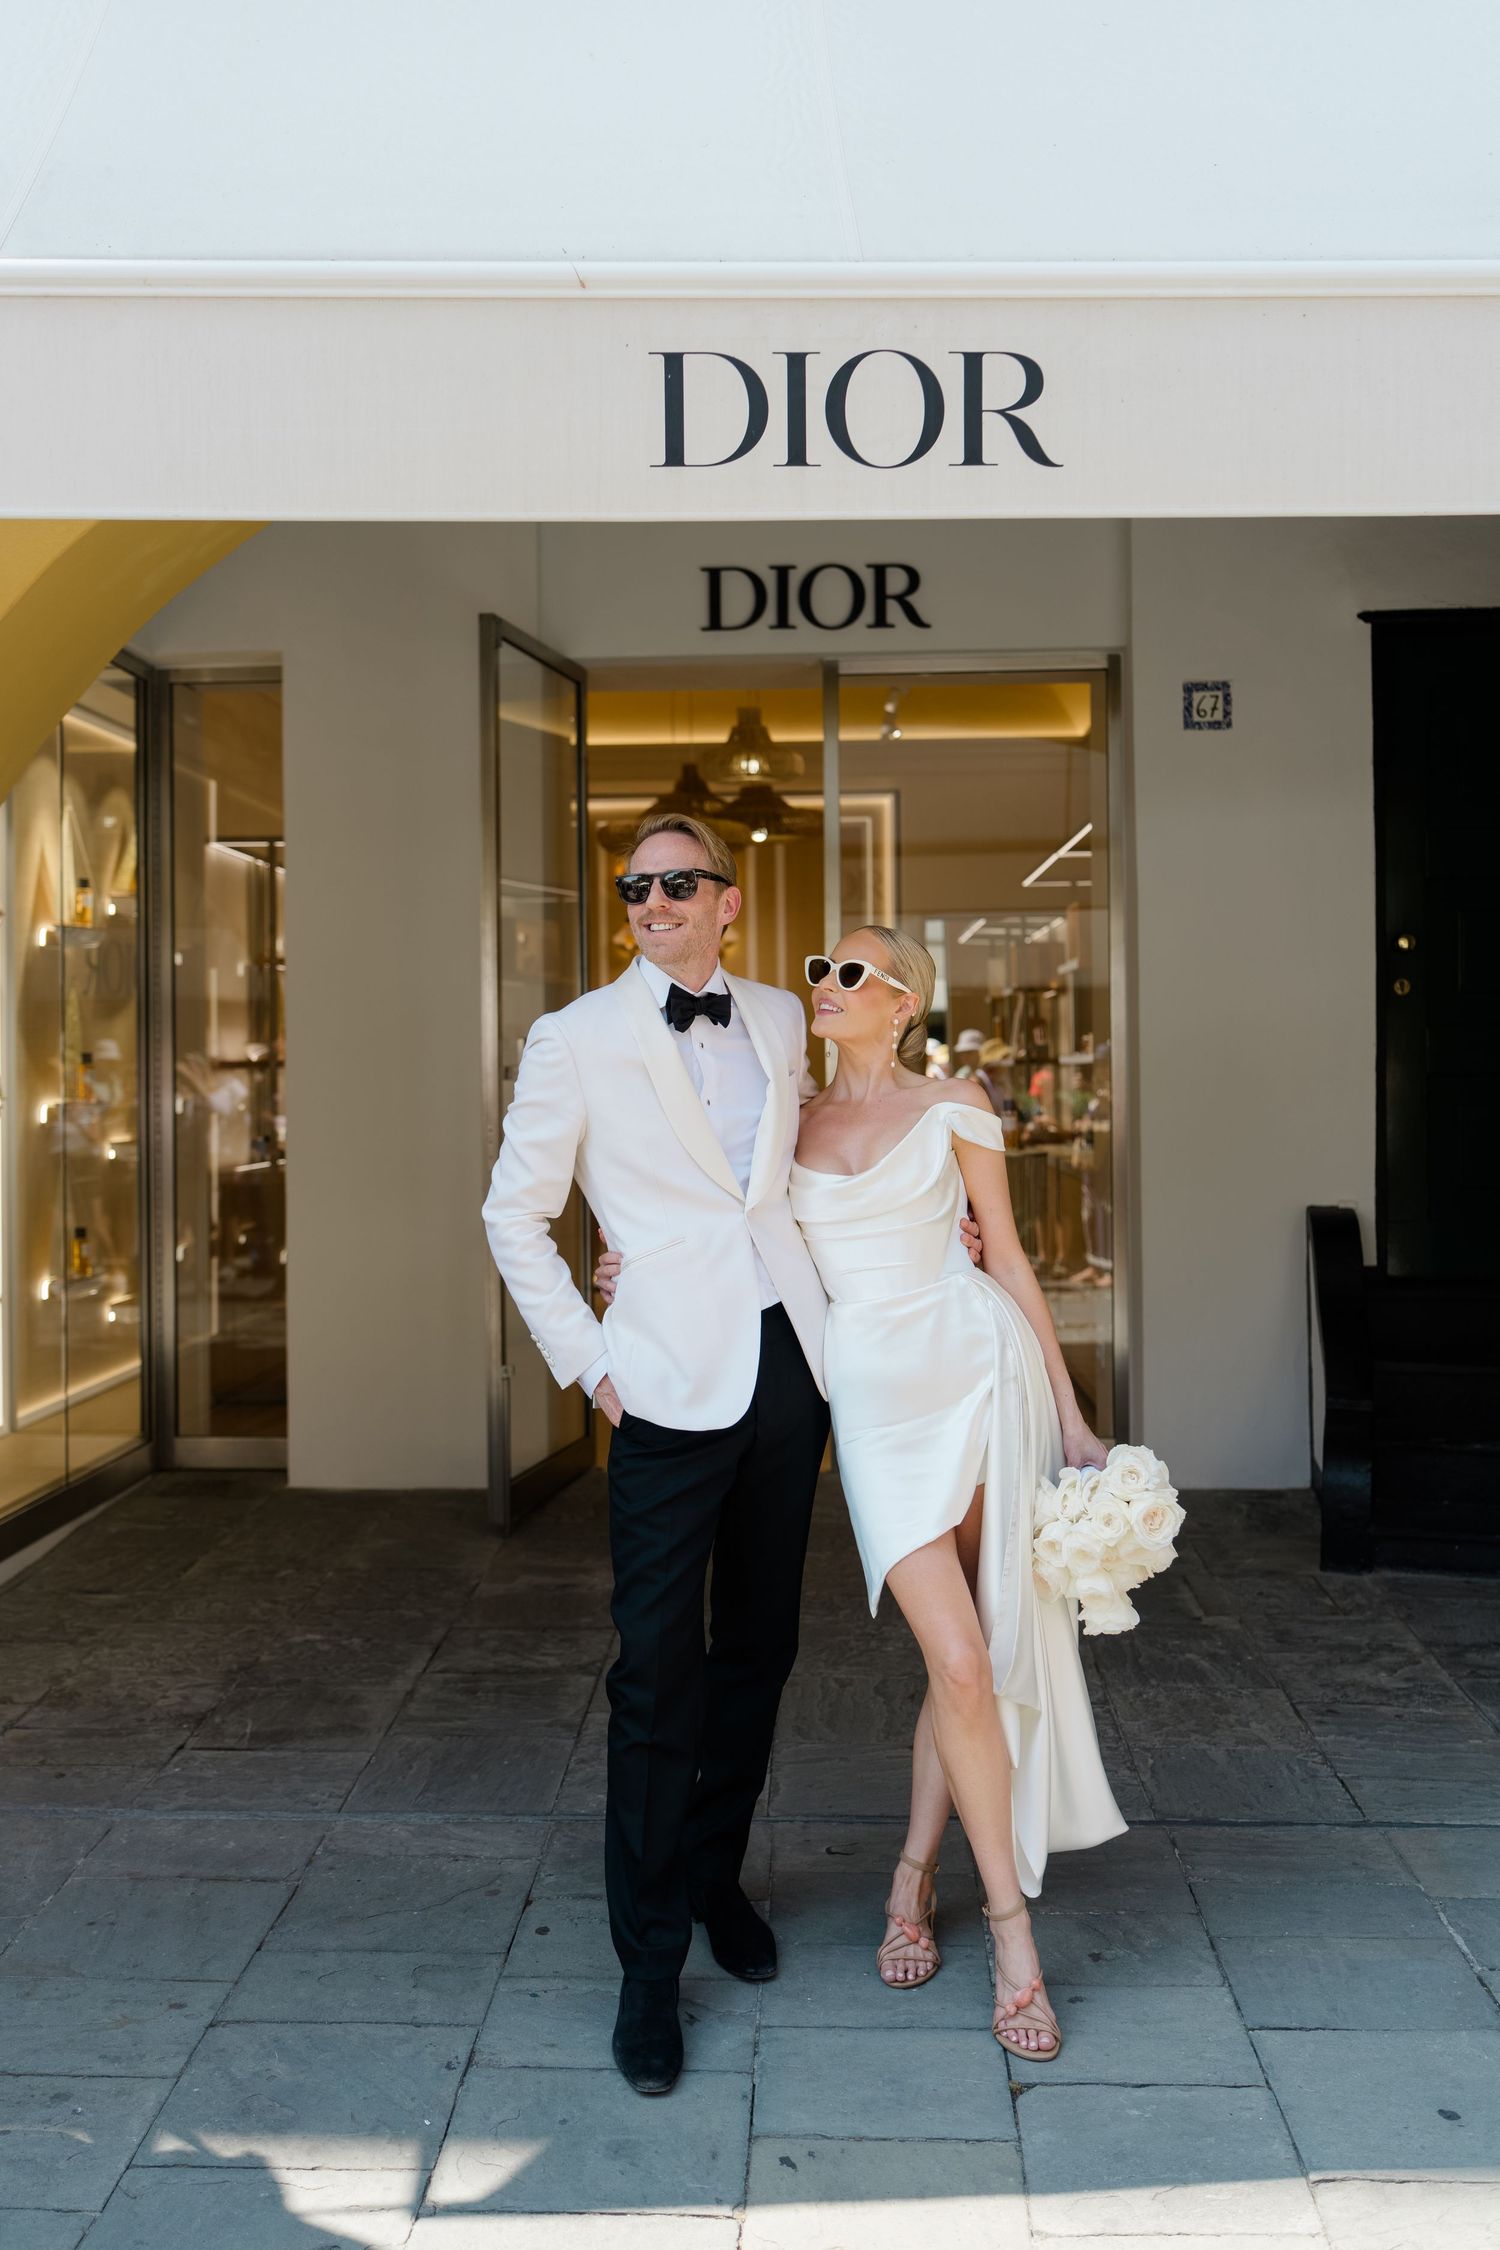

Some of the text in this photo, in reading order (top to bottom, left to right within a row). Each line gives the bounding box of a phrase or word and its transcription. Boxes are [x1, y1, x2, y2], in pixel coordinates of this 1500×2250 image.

[648, 349, 1064, 469] DIOR
[699, 562, 932, 632] DIOR
[1195, 693, 1220, 719] 67
